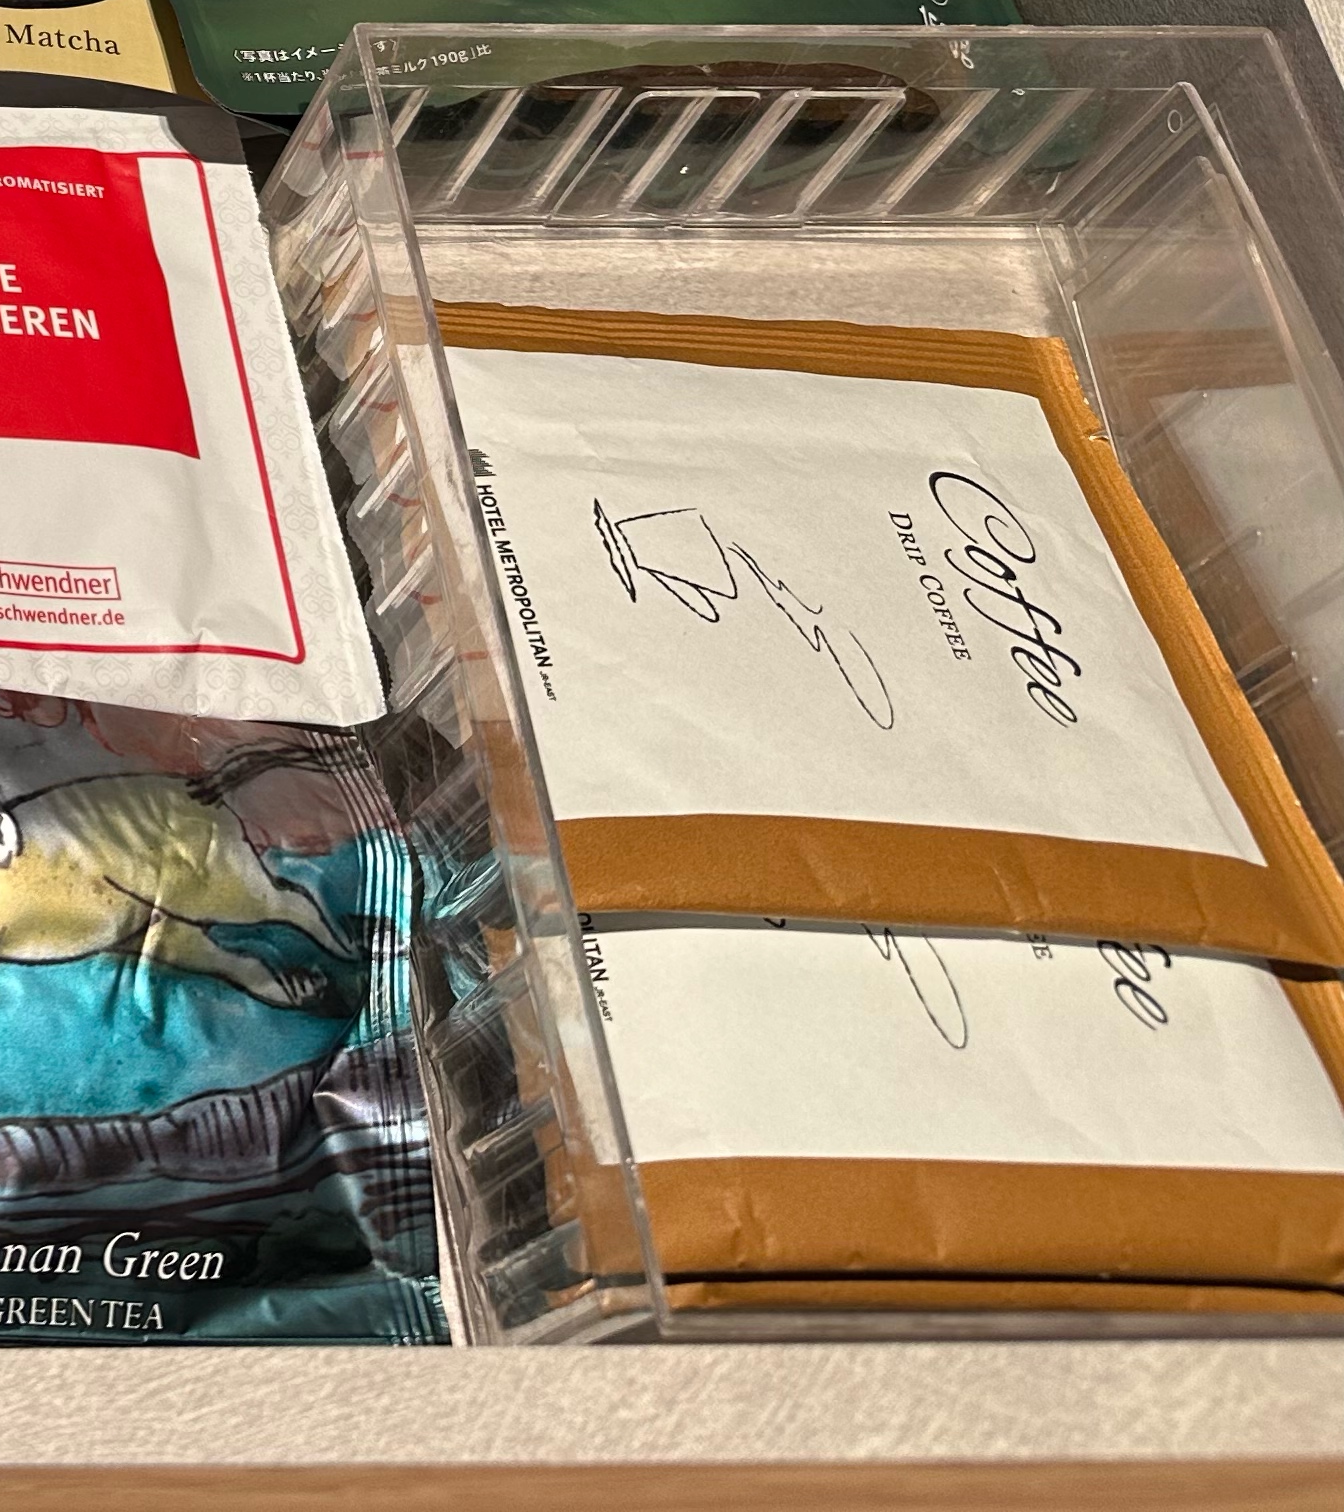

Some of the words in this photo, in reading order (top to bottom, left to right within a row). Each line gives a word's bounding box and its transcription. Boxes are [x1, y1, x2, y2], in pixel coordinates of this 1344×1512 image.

[5, 23, 122, 58] Matcha
[476, 483, 505, 536] HOTEL
[492, 537, 554, 670] METROPOLITAN
[888, 510, 927, 568] DRIP
[916, 574, 973, 662] COFFEE
[929, 471, 1083, 730] Coffee
[103, 1230, 225, 1282] Green
[99, 1300, 166, 1331] TEA
